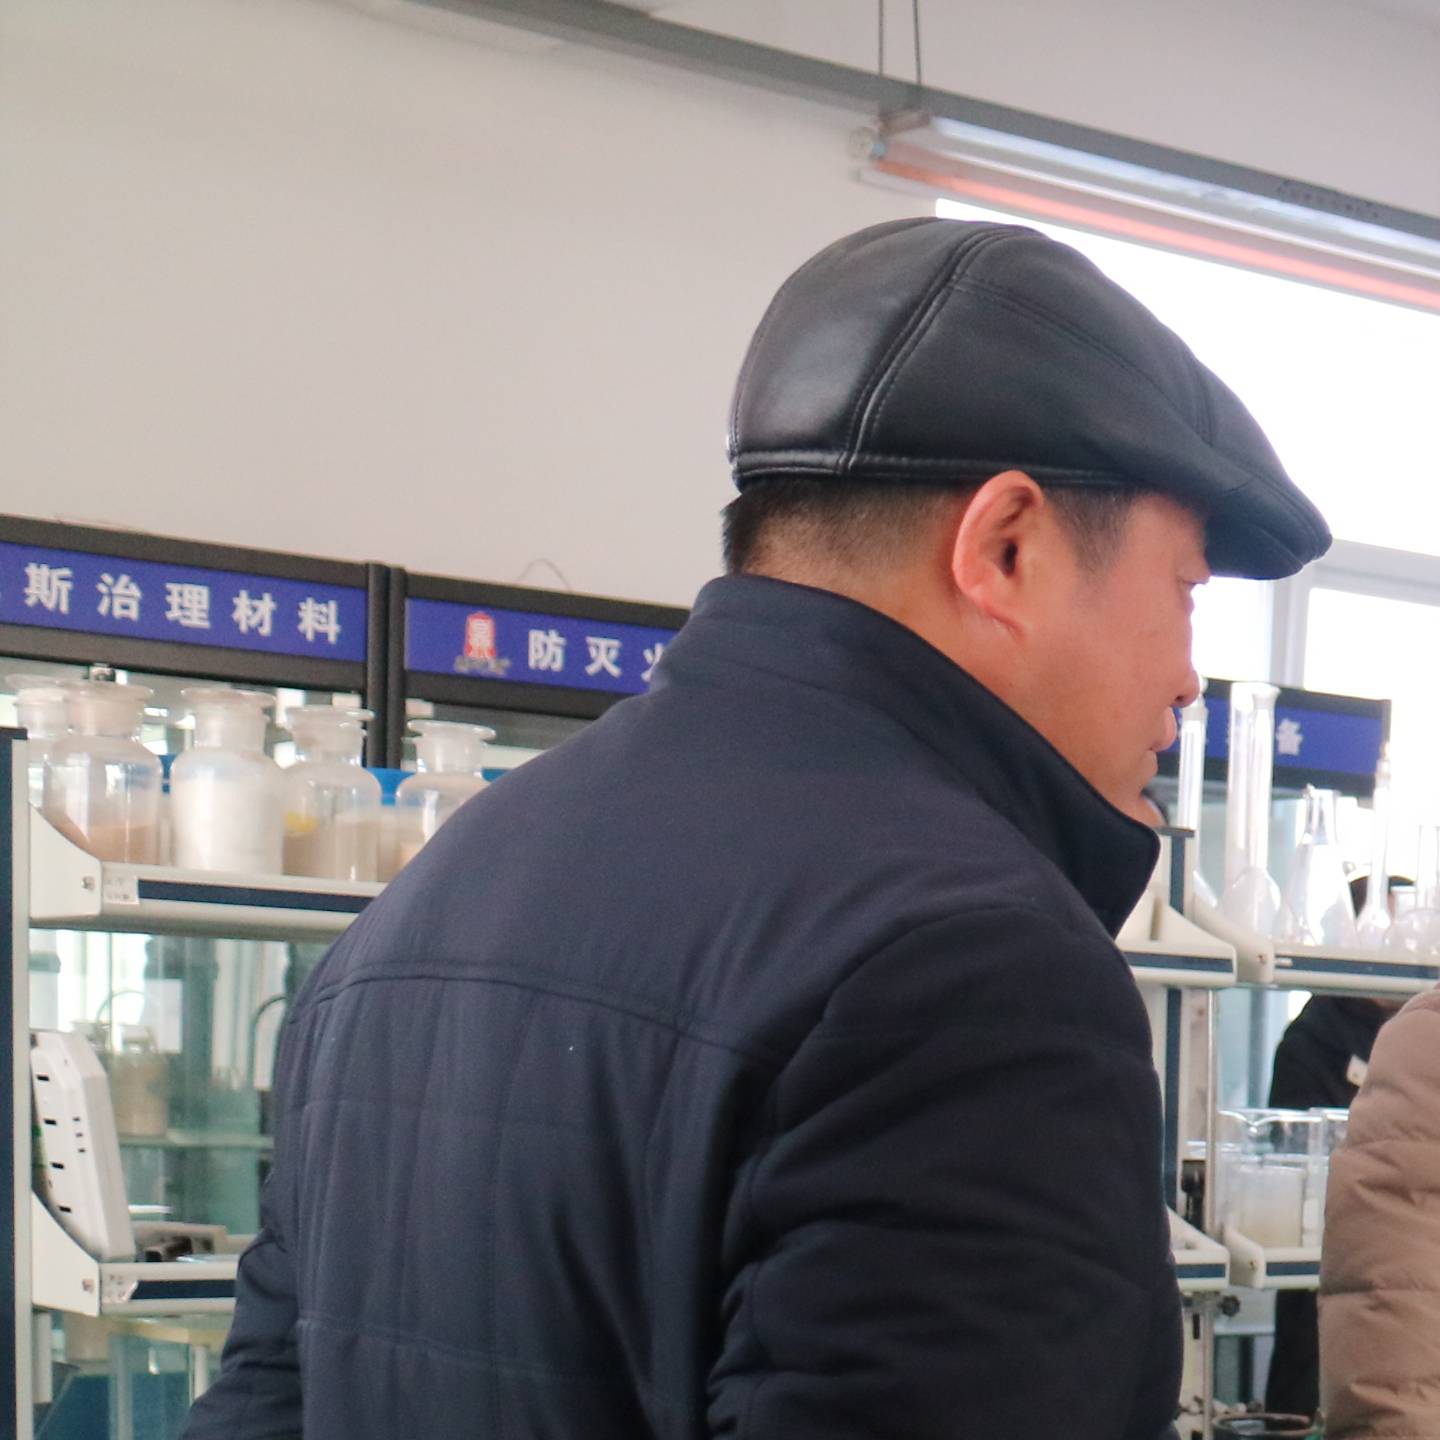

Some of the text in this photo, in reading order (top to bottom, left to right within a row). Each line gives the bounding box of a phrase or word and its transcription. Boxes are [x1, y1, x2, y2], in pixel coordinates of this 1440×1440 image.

[23, 562, 341, 645] 斯治理材料
